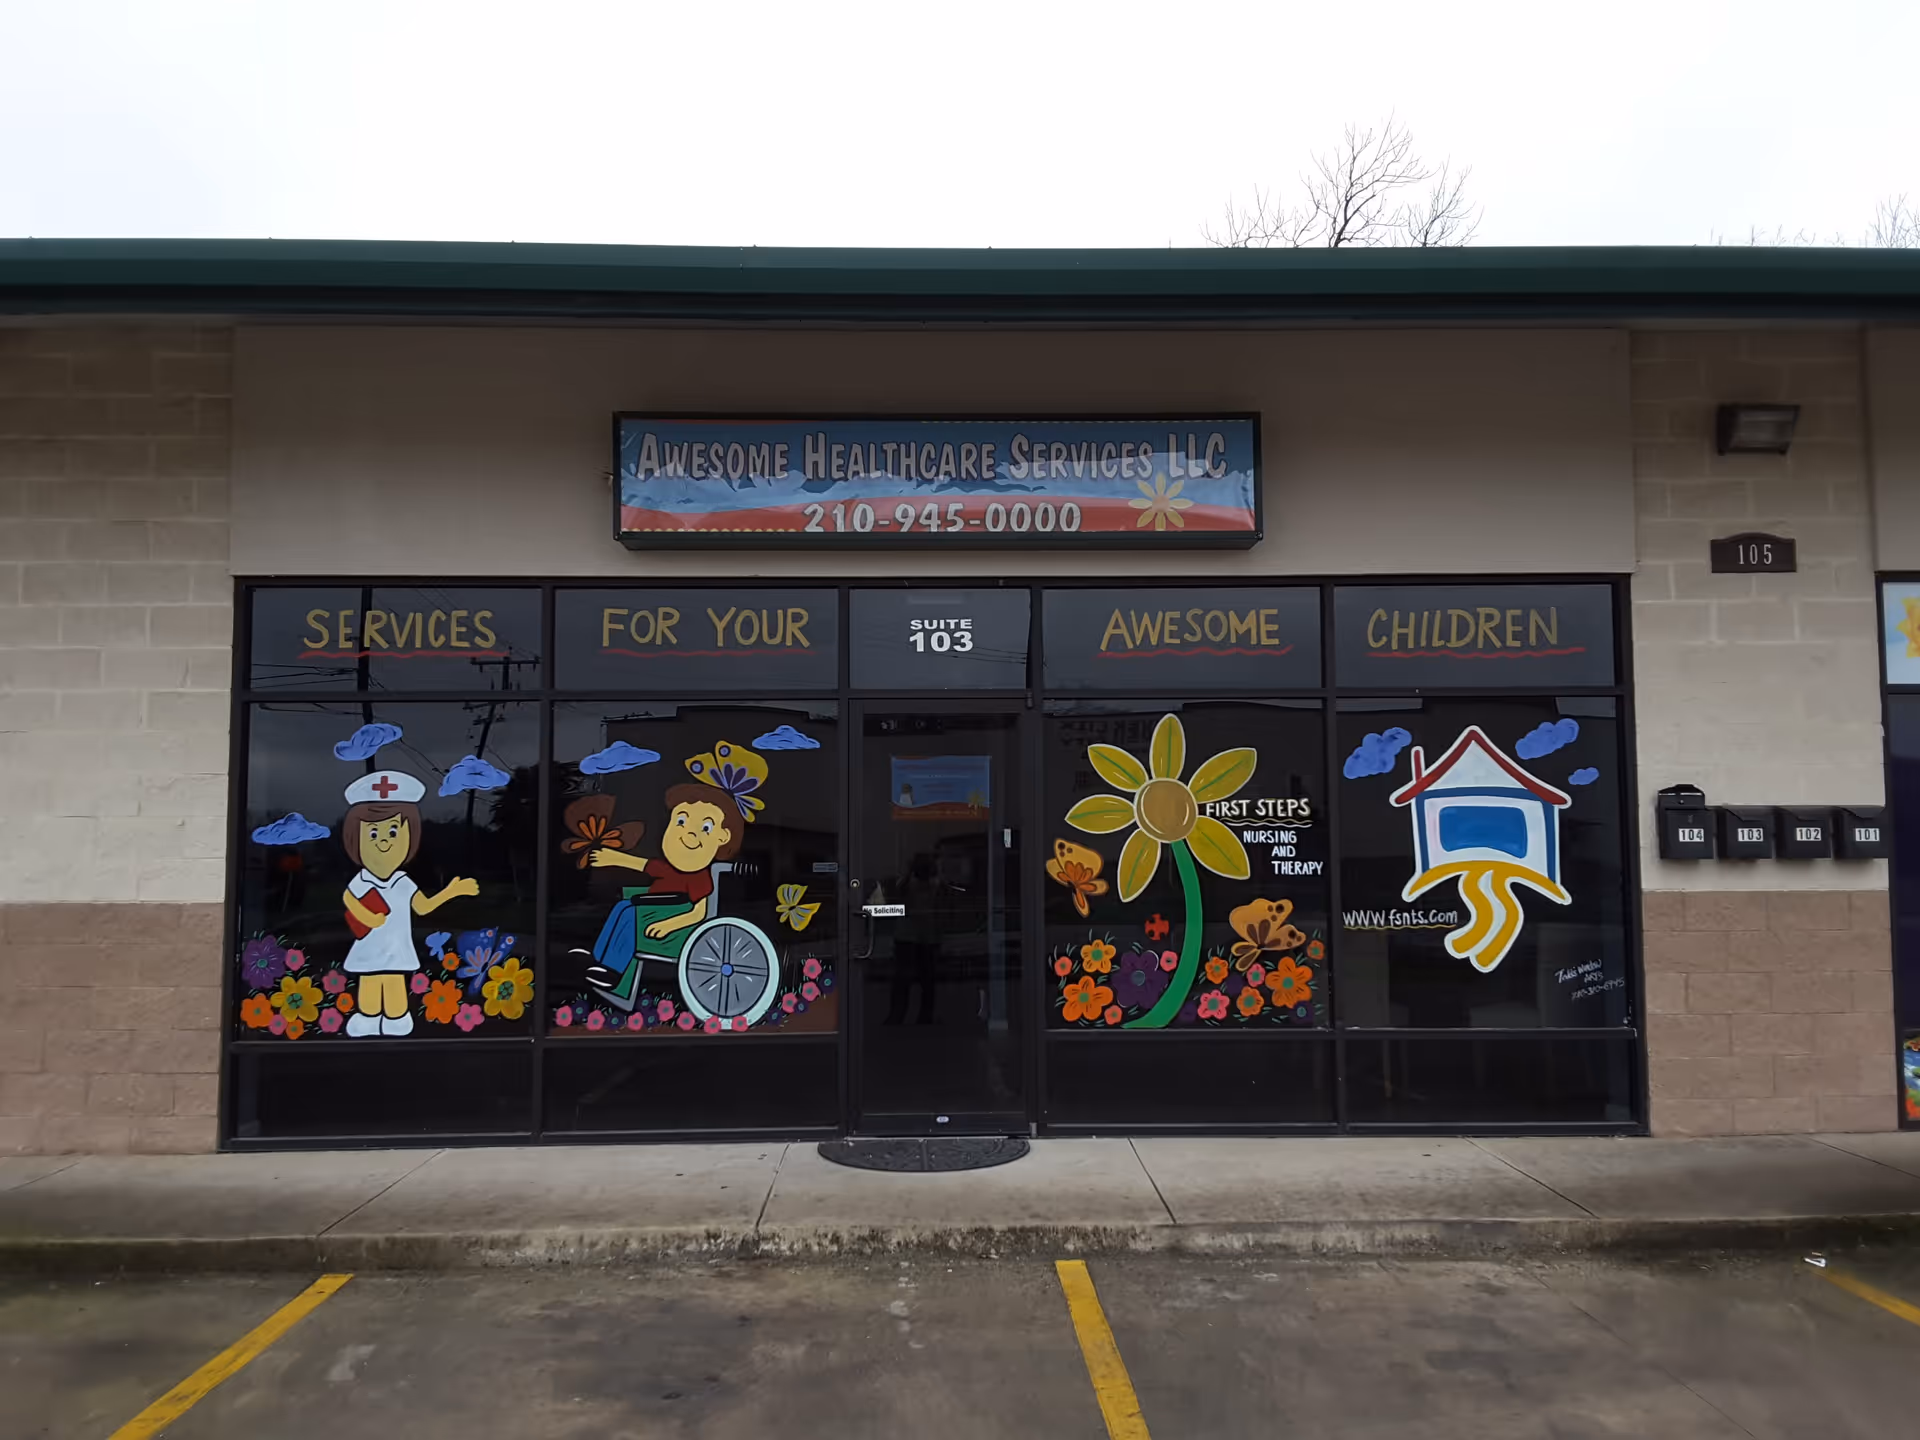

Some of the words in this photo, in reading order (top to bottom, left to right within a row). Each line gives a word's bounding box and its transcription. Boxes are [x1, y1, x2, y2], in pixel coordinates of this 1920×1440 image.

[636, 432, 789, 481] AWESOME
[804, 432, 995, 481] HEALTHCARE
[1009, 434, 1153, 481] SERVICES
[1168, 433, 1227, 480] LLC
[803, 502, 1082, 532] 210-945-0000
[1738, 544, 1773, 565] 105
[303, 608, 497, 649] SERVICES
[602, 608, 679, 647] FOR
[707, 607, 811, 648] YOUR
[910, 619, 973, 630] SUITE
[1100, 607, 1280, 651] AWESOME
[1367, 606, 1558, 650] CHILDREN
[909, 631, 974, 652] 103
[1206, 799, 1251, 817] FIRST
[1255, 798, 1311, 816] STEPS
[1243, 830, 1297, 843] NURSING
[1680, 830, 1703, 841] 104
[1740, 829, 1762, 840] 103
[1799, 829, 1820, 840] 102
[1857, 829, 1879, 840] 101
[1271, 845, 1296, 857] AND
[1271, 861, 1323, 875] THERAPY
